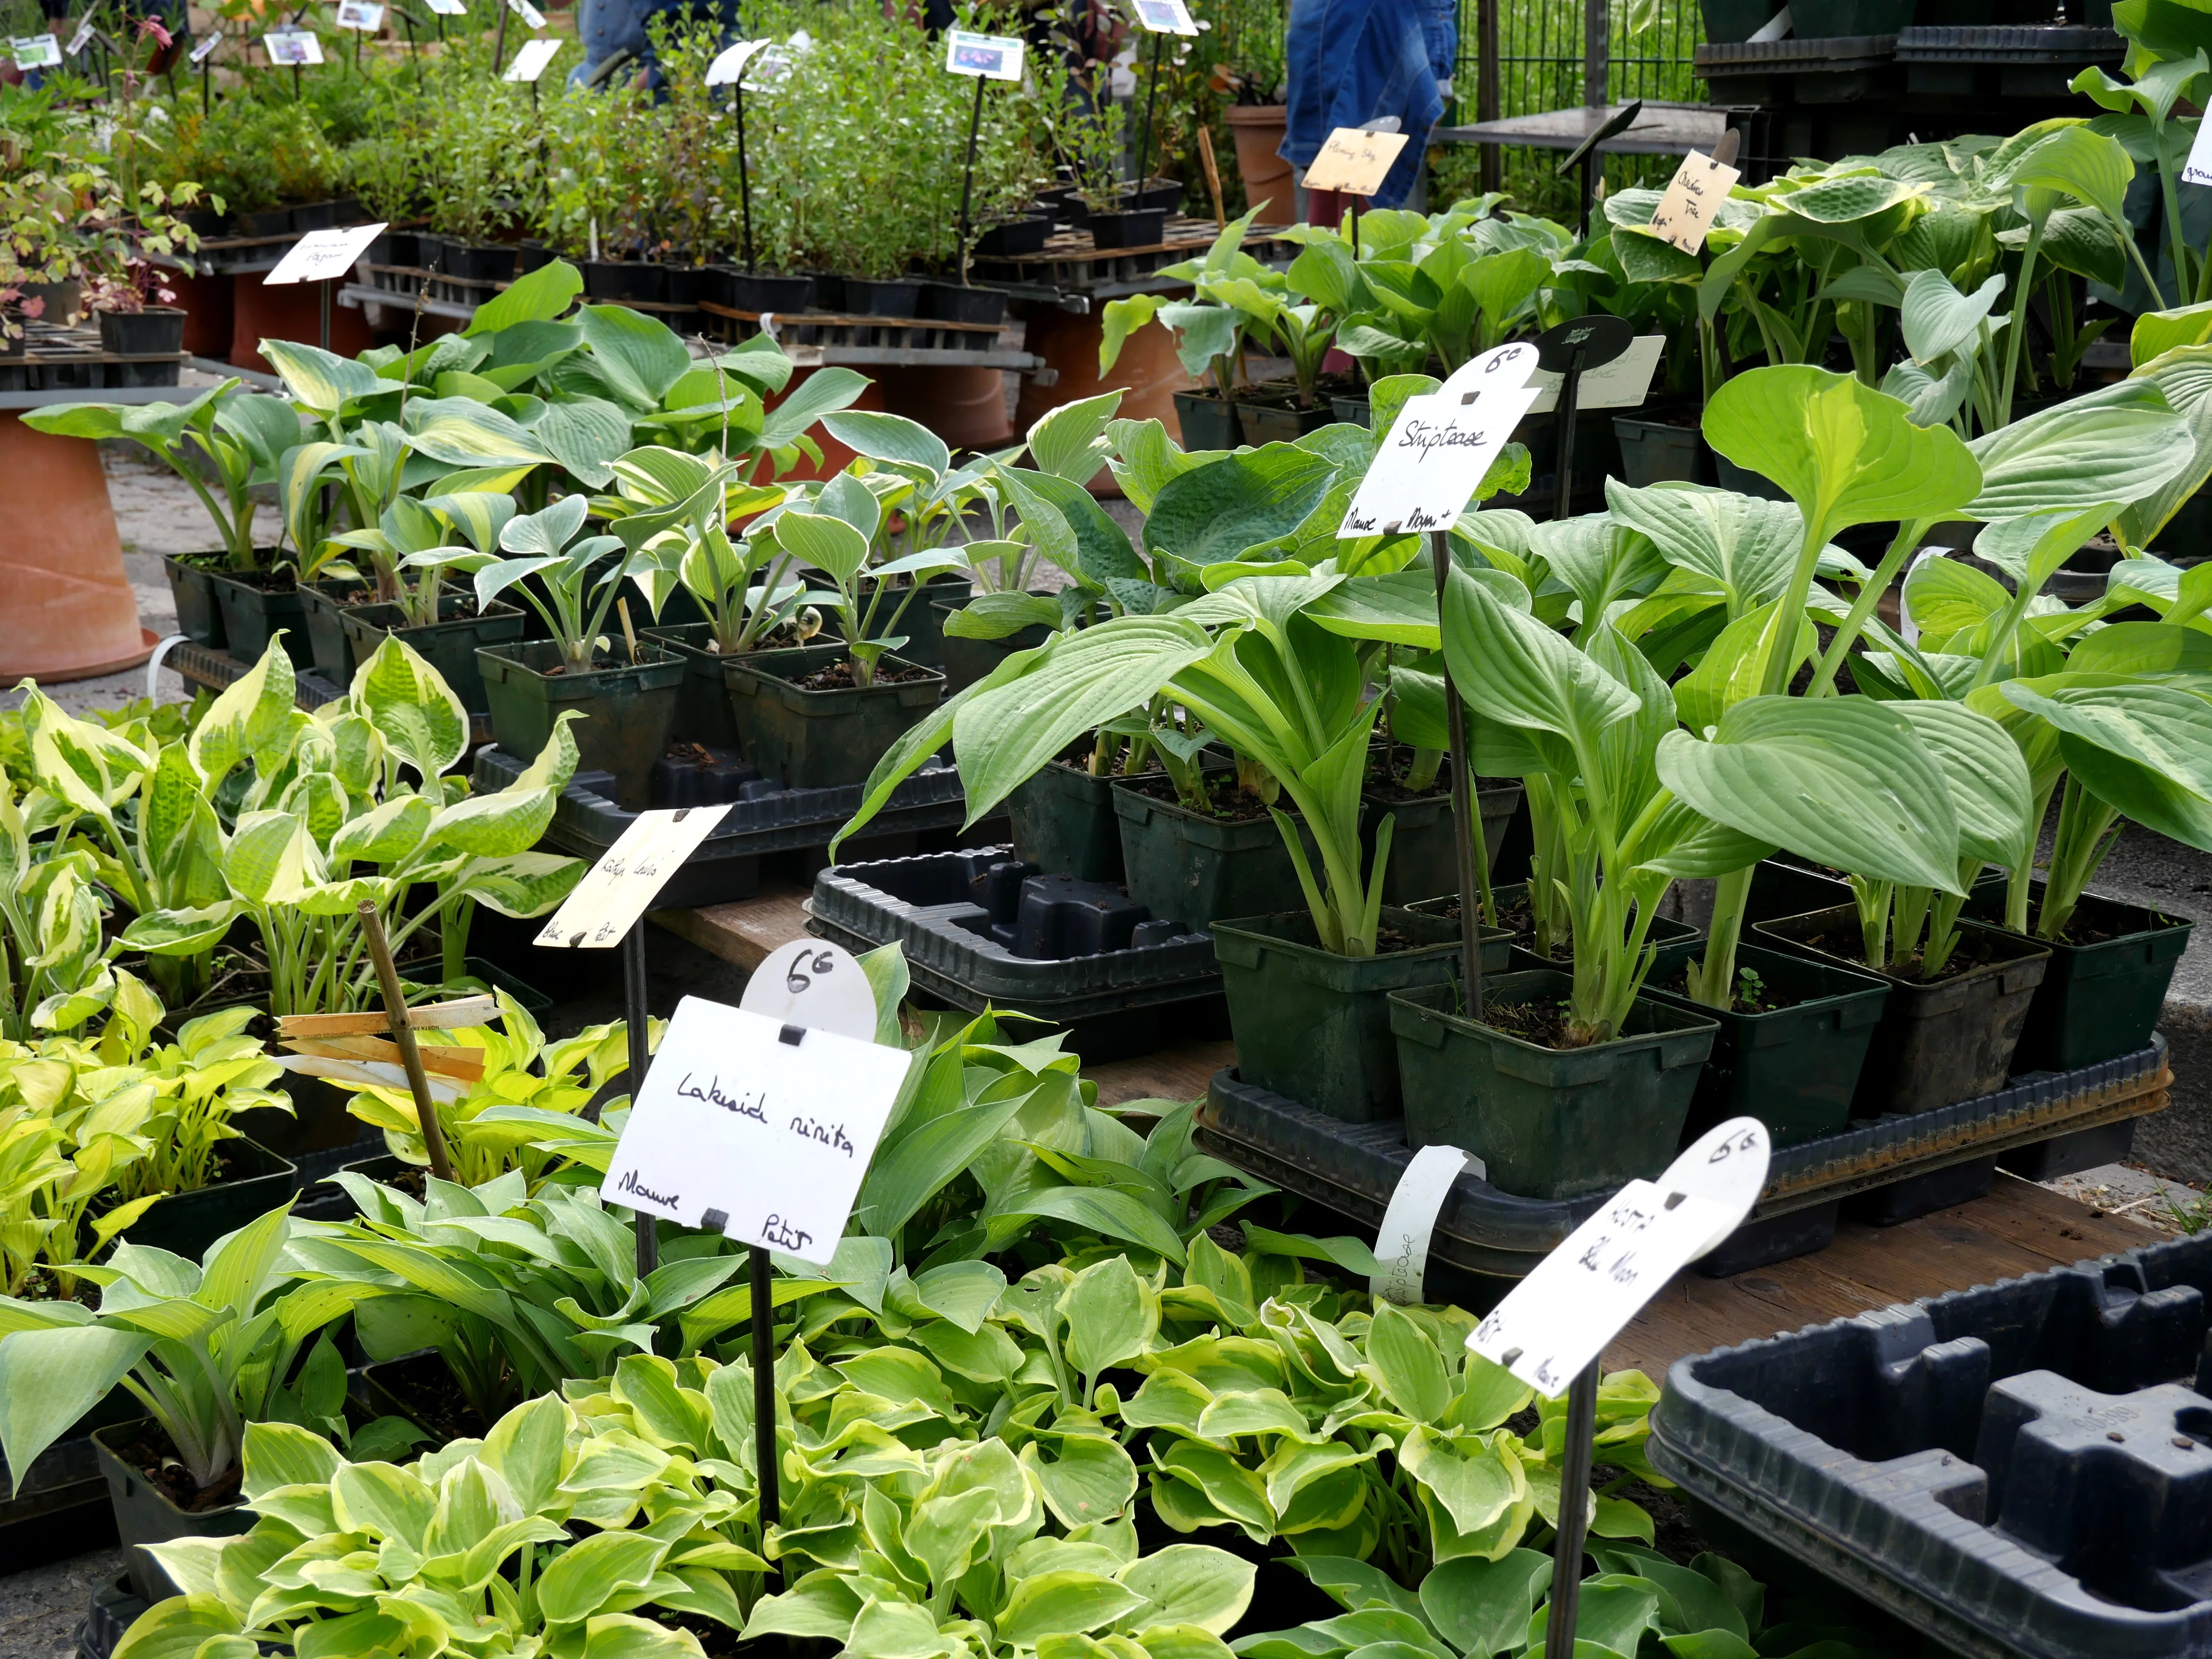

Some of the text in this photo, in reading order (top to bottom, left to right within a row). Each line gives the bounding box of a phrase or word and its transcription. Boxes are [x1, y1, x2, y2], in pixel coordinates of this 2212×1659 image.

[1685, 199, 1699, 218] Tree
[1398, 419, 1488, 464] Striptease
[618, 1169, 680, 1211] Mauve
